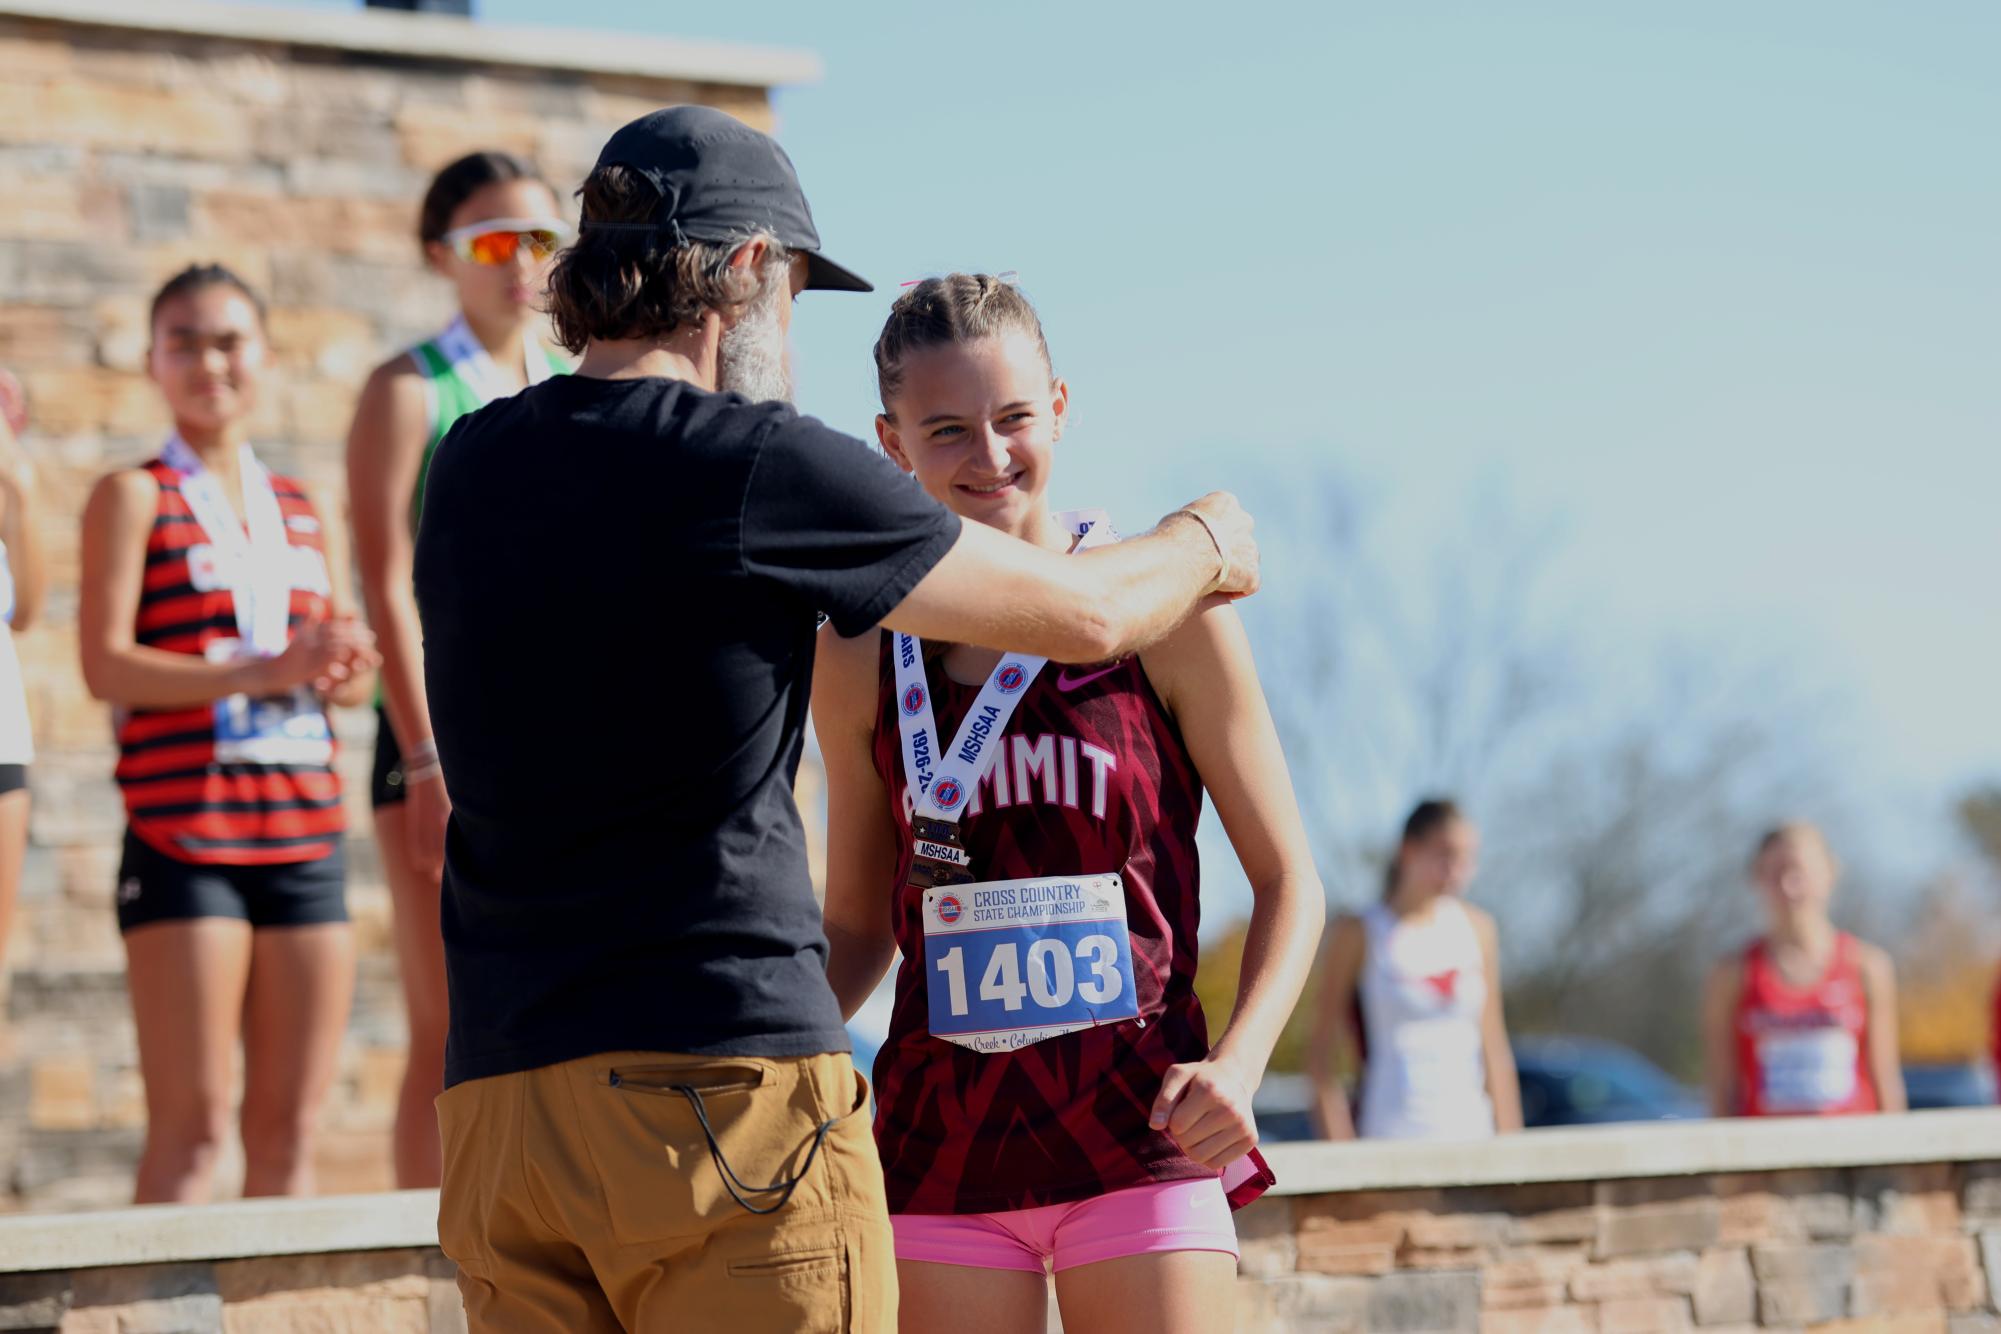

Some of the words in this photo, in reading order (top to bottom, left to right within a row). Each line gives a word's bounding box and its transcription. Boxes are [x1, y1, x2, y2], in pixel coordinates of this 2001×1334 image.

[901, 633, 915, 669] ARS
[958, 705, 1001, 765] MSHSAA
[902, 733, 1117, 828] MMIT
[920, 842, 960, 863] MSHSAA
[974, 890, 1016, 908] CROSS
[1020, 884, 1081, 904] COUNTRY
[973, 908, 1005, 922] STATE
[1007, 901, 1086, 919] CHAMPIONSHIP
[936, 934, 1123, 1016] 1403
[974, 1035, 1000, 1051] Creek
